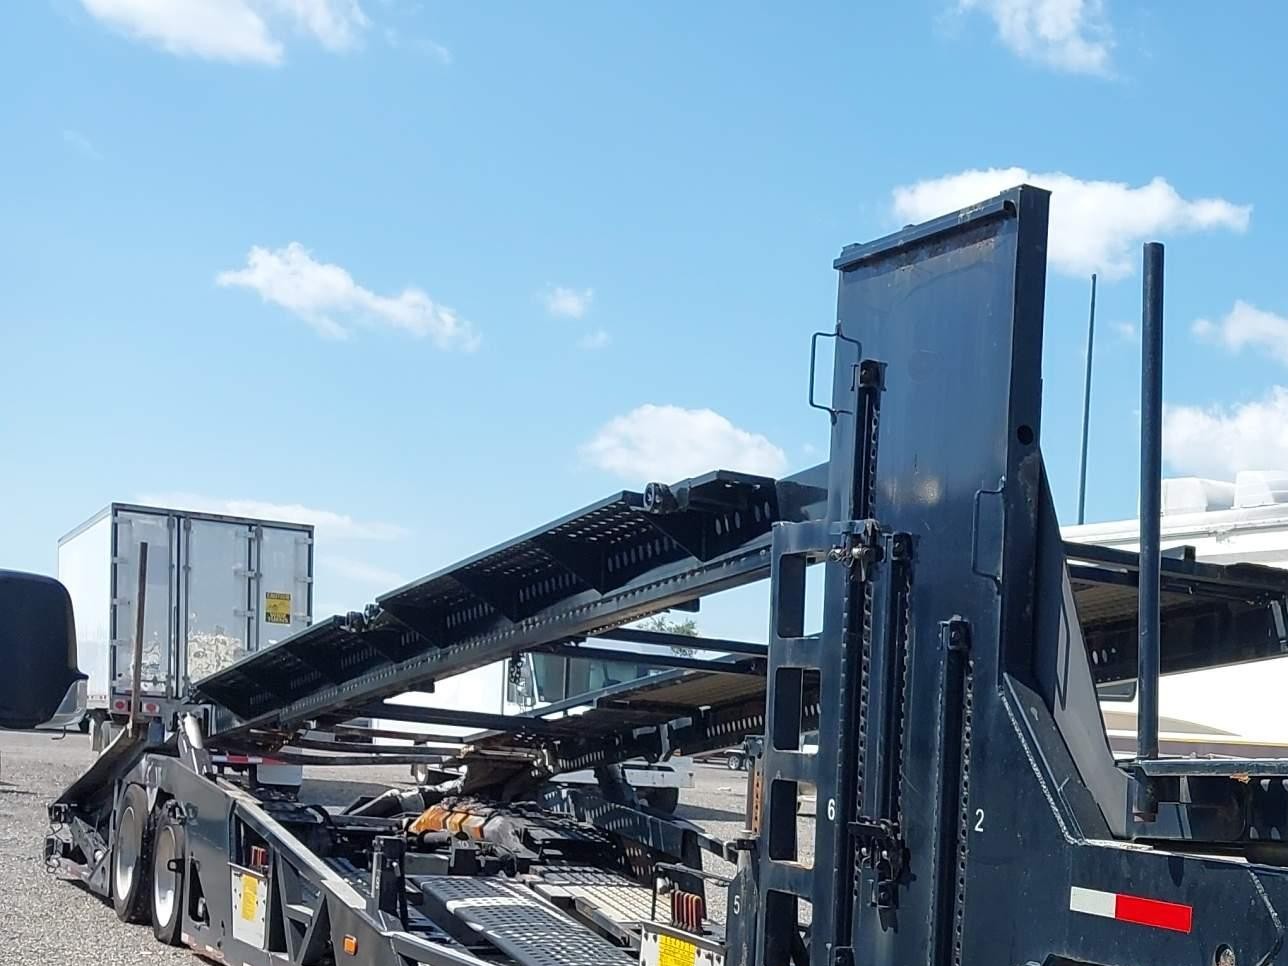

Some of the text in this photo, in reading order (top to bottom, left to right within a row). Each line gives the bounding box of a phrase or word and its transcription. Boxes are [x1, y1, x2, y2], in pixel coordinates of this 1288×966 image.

[827, 799, 836, 821] 6
[974, 808, 985, 832] 2
[733, 894, 741, 915] 5
